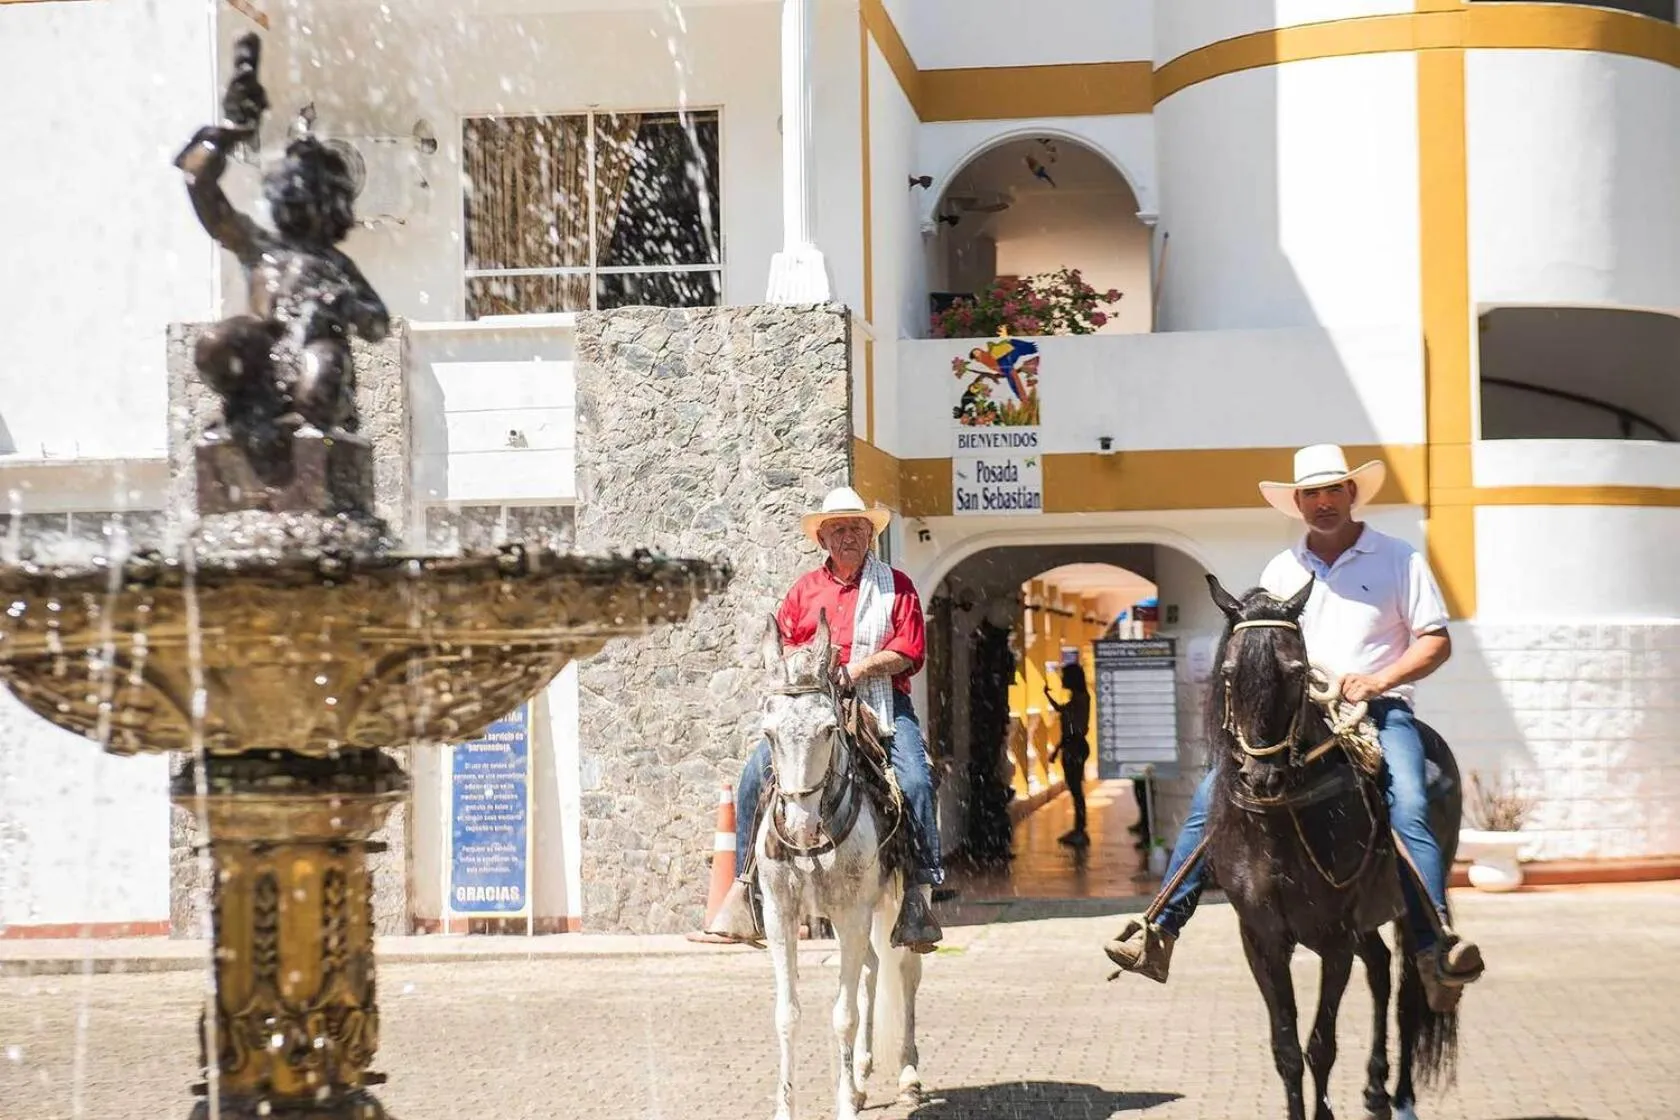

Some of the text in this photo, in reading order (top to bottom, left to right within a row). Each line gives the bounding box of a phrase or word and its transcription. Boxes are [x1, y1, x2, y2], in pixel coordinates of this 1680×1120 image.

[958, 432, 1038, 449] BIENVENIDOS
[976, 459, 1018, 483] Posada
[957, 487, 979, 510] San
[456, 885, 521, 903] GRACIAS
